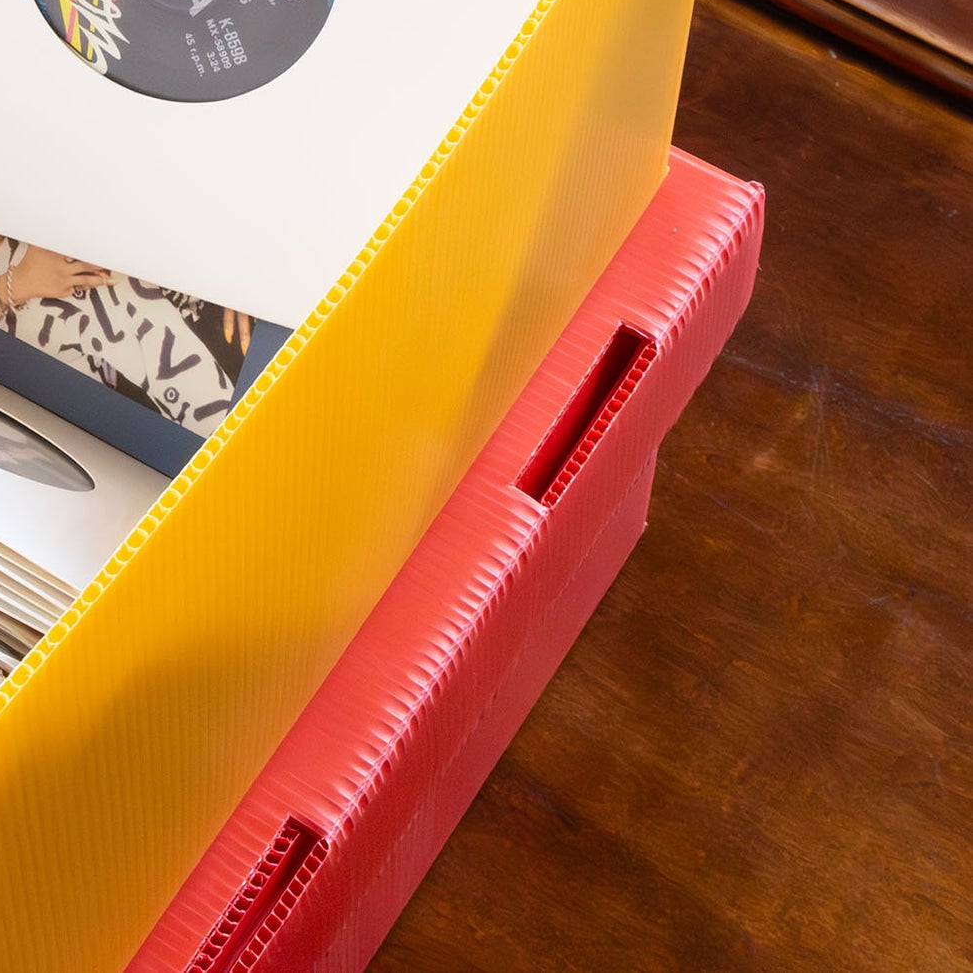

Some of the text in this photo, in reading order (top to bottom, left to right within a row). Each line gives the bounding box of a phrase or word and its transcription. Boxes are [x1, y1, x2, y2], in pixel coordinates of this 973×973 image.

[185, 33, 205, 78] 45 r.p.m.
[206, 18, 232, 69] MX-58909
[206, 50, 221, 73] 3:24
[218, 17, 248, 65] K-8598
